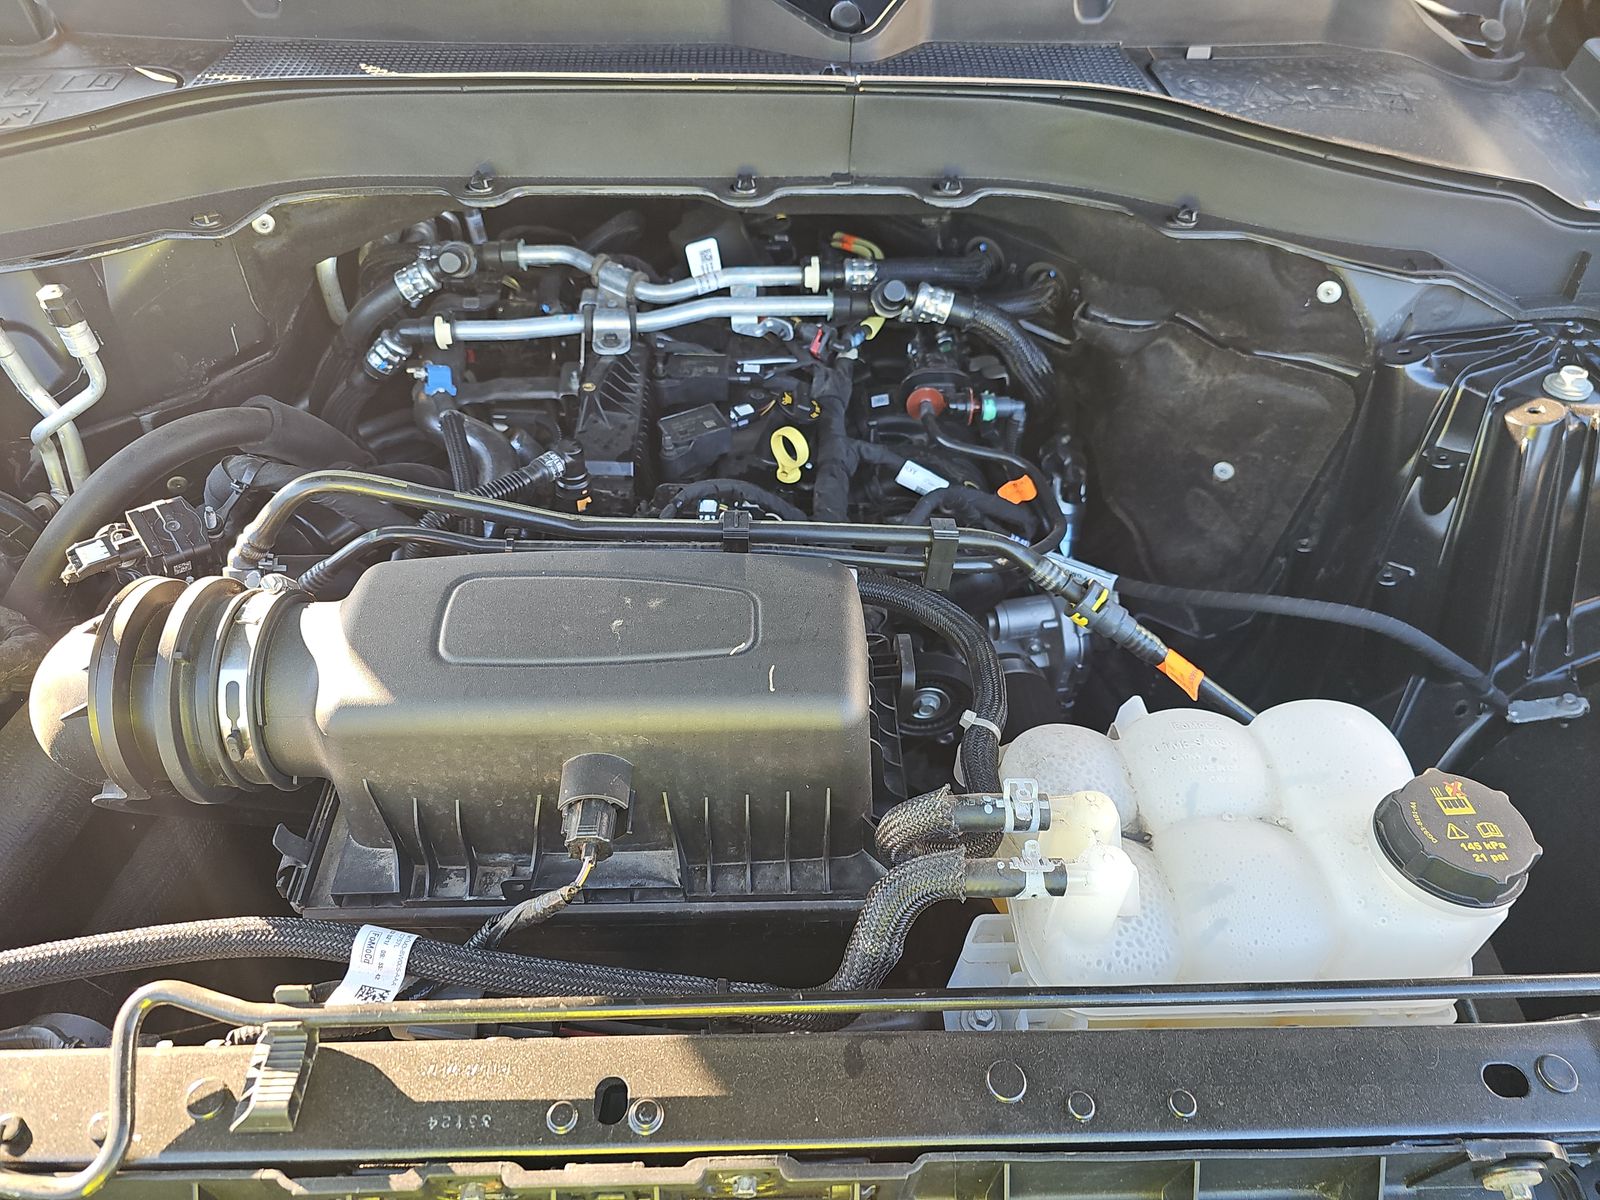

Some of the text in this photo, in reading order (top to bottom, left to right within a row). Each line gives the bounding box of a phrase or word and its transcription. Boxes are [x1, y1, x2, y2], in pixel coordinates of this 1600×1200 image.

[1460, 841, 1507, 851] 145 kPa
[1472, 852, 1509, 863] 21 psi
[363, 932, 380, 964] FoMoCo
